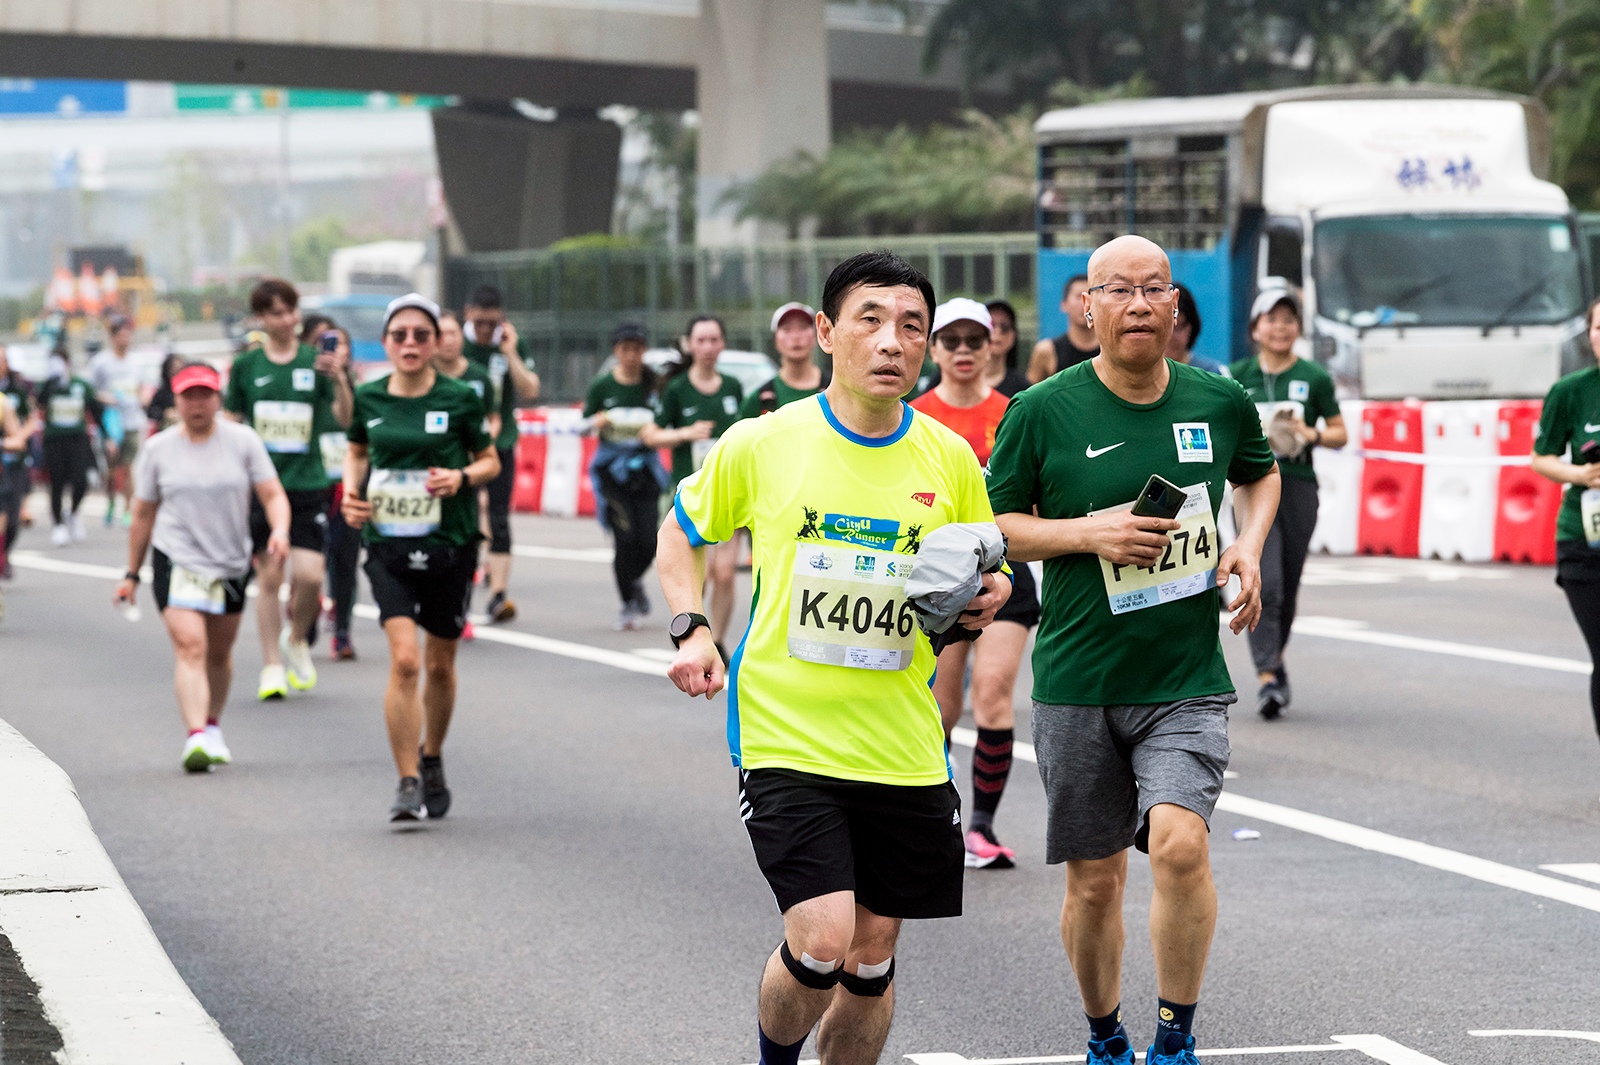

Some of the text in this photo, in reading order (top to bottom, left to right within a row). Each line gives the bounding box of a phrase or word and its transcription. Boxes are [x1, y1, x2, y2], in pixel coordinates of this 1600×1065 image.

[372, 495, 435, 517] P4627
[834, 518, 871, 533] CityU
[842, 528, 888, 544] Runner
[799, 589, 913, 638] K4046
[1117, 602, 1131, 610] 10KM
